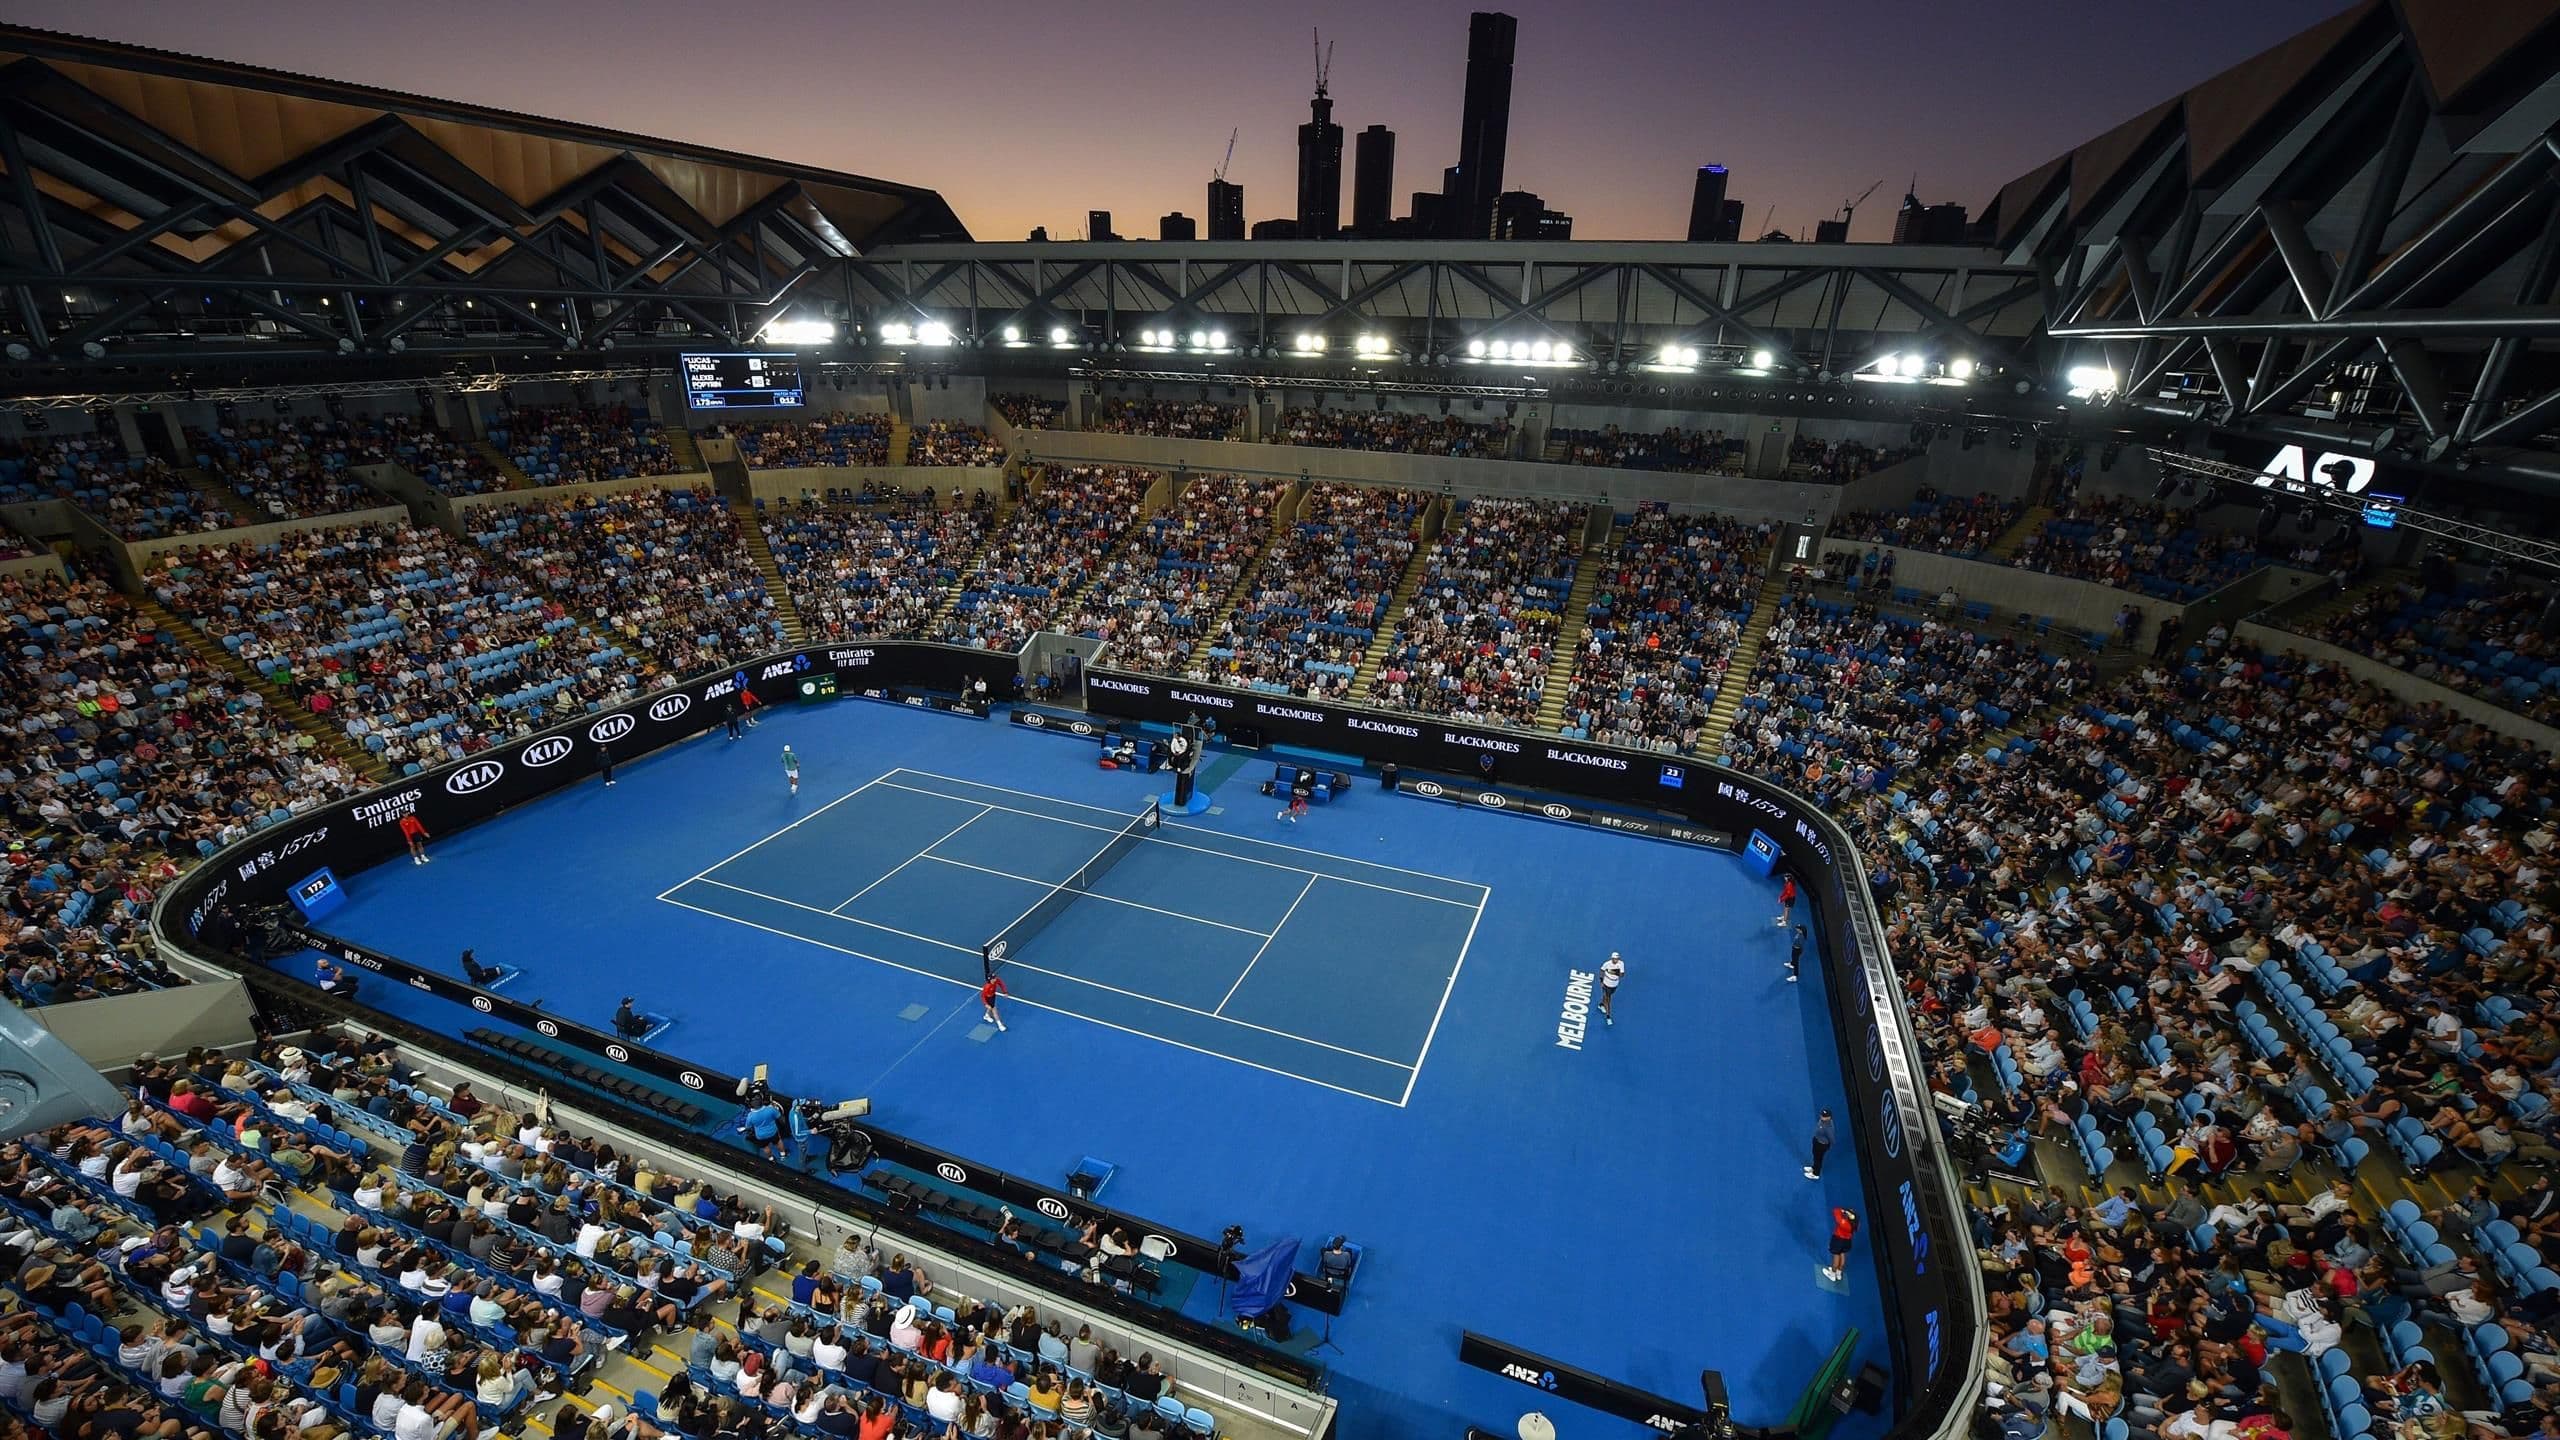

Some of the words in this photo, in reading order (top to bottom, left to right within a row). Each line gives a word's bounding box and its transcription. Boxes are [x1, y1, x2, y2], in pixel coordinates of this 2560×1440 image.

[829, 648, 875, 662] Emirates
[761, 661, 794, 681] ANZ
[704, 682, 735, 701] ANZ
[864, 688, 880, 698] ANZ
[1090, 677, 1150, 695] BLACKMORES
[656, 698, 685, 717] KIA
[905, 696, 923, 706] ANZ
[1171, 690, 1234, 708] BLACKMORES
[1257, 704, 1324, 722] BLACKMORES
[597, 718, 628, 739] KIA
[1347, 718, 1419, 738] BLACKMORES
[530, 740, 566, 763] KIA
[1444, 733, 1520, 753] BLACKMORES
[1547, 749, 1627, 770] BLACKMORES
[455, 766, 496, 790] KIA
[352, 788, 422, 821] Emirates
[368, 814, 382, 829] FLY
[307, 880, 324, 894] 173
[1555, 969, 1595, 1051] MELBOURNE
[1899, 1180, 1920, 1247] ANZ
[1925, 1310, 1940, 1383] ANZ
[1501, 1363, 1540, 1385] ANZ
